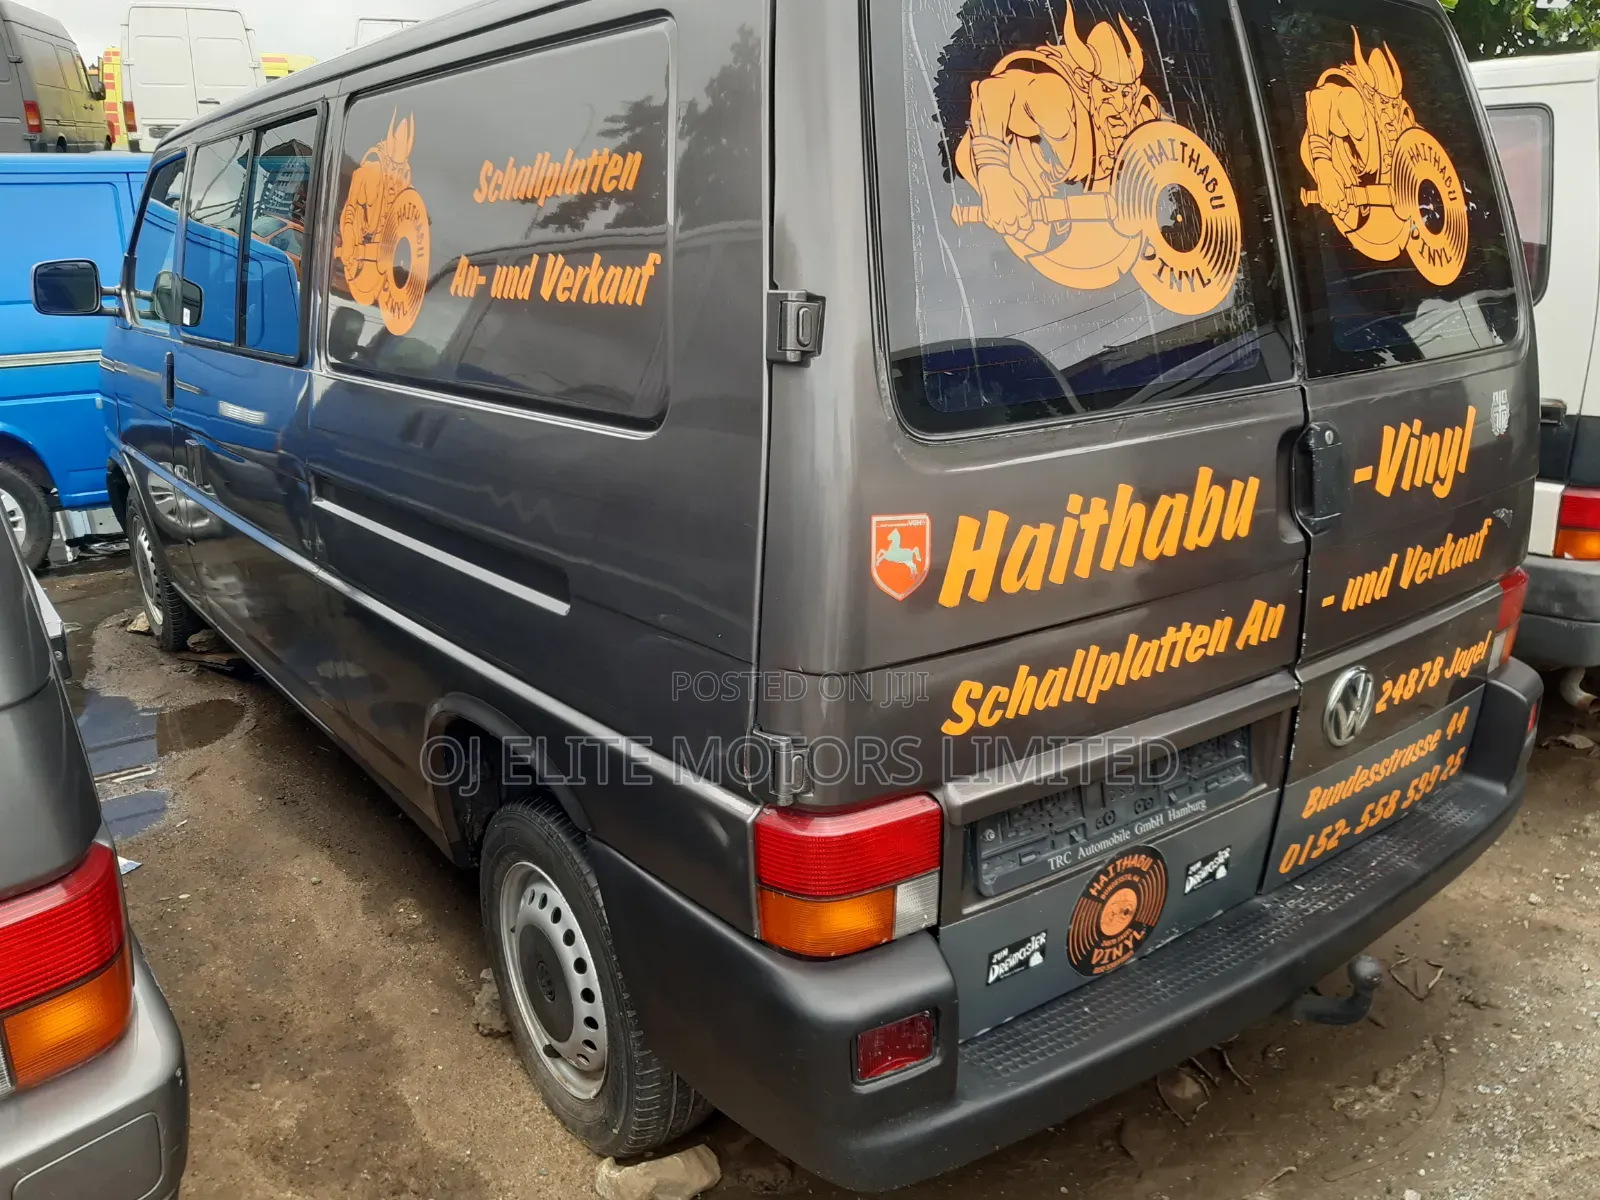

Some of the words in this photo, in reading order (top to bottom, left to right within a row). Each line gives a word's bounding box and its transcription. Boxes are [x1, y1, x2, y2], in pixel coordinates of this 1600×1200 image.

[473, 148, 643, 207] Schallplatten
[450, 254, 487, 298] An-
[490, 253, 540, 301] und
[539, 252, 662, 306] Verkauf
[937, 465, 1261, 609] Haithabu
[940, 616, 1234, 736] Schallplatten
[1234, 599, 1286, 651] An
[1399, 517, 1493, 590] Verkauf
[1374, 655, 1446, 714] 24878
[1443, 630, 1493, 679] Jagel
[1301, 729, 1443, 819] Bundesstrasse
[1445, 705, 1470, 741] 44
[1354, 789, 1402, 835] 558
[1400, 764, 1441, 809] 599
[1439, 745, 1466, 782] 25
[1047, 852, 1072, 871] TRC
[1077, 829, 1131, 860] Automobile
[1134, 814, 1165, 836] GmbH
[1167, 799, 1208, 822] Hamburg
[1088, 853, 1154, 897] HAITHABU
